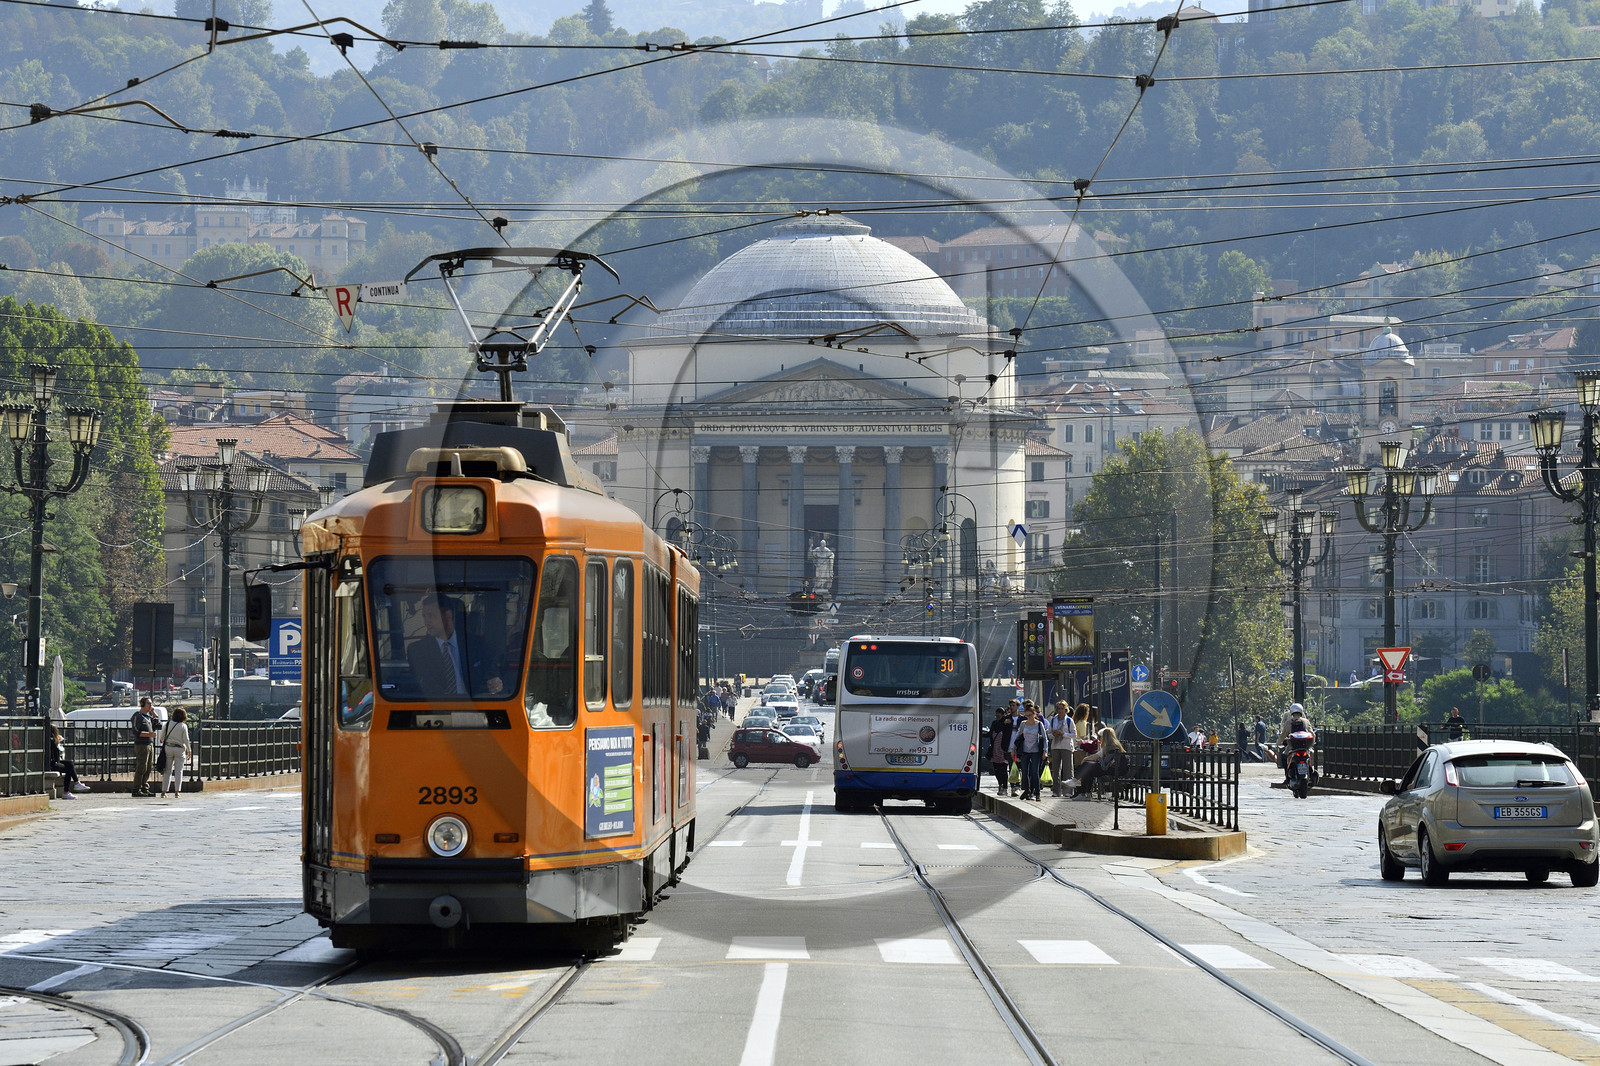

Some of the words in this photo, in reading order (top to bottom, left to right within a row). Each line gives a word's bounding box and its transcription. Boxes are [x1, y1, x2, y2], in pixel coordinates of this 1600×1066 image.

[369, 285, 400, 297] CONTINUA
[335, 287, 353, 317] R
[700, 423, 725, 432] ORDO
[730, 423, 787, 433] POPVLVSQVE
[793, 424, 838, 432] TAVRINVS
[843, 424, 854, 432] OB
[858, 424, 912, 433] ADVENTVM
[917, 424, 943, 433] REGIS
[940, 658, 954, 672] 30
[907, 715, 934, 723] Piemonte
[418, 786, 478, 805] 2893
[1501, 807, 1512, 816] EB
[1514, 807, 1541, 817] 355GS
